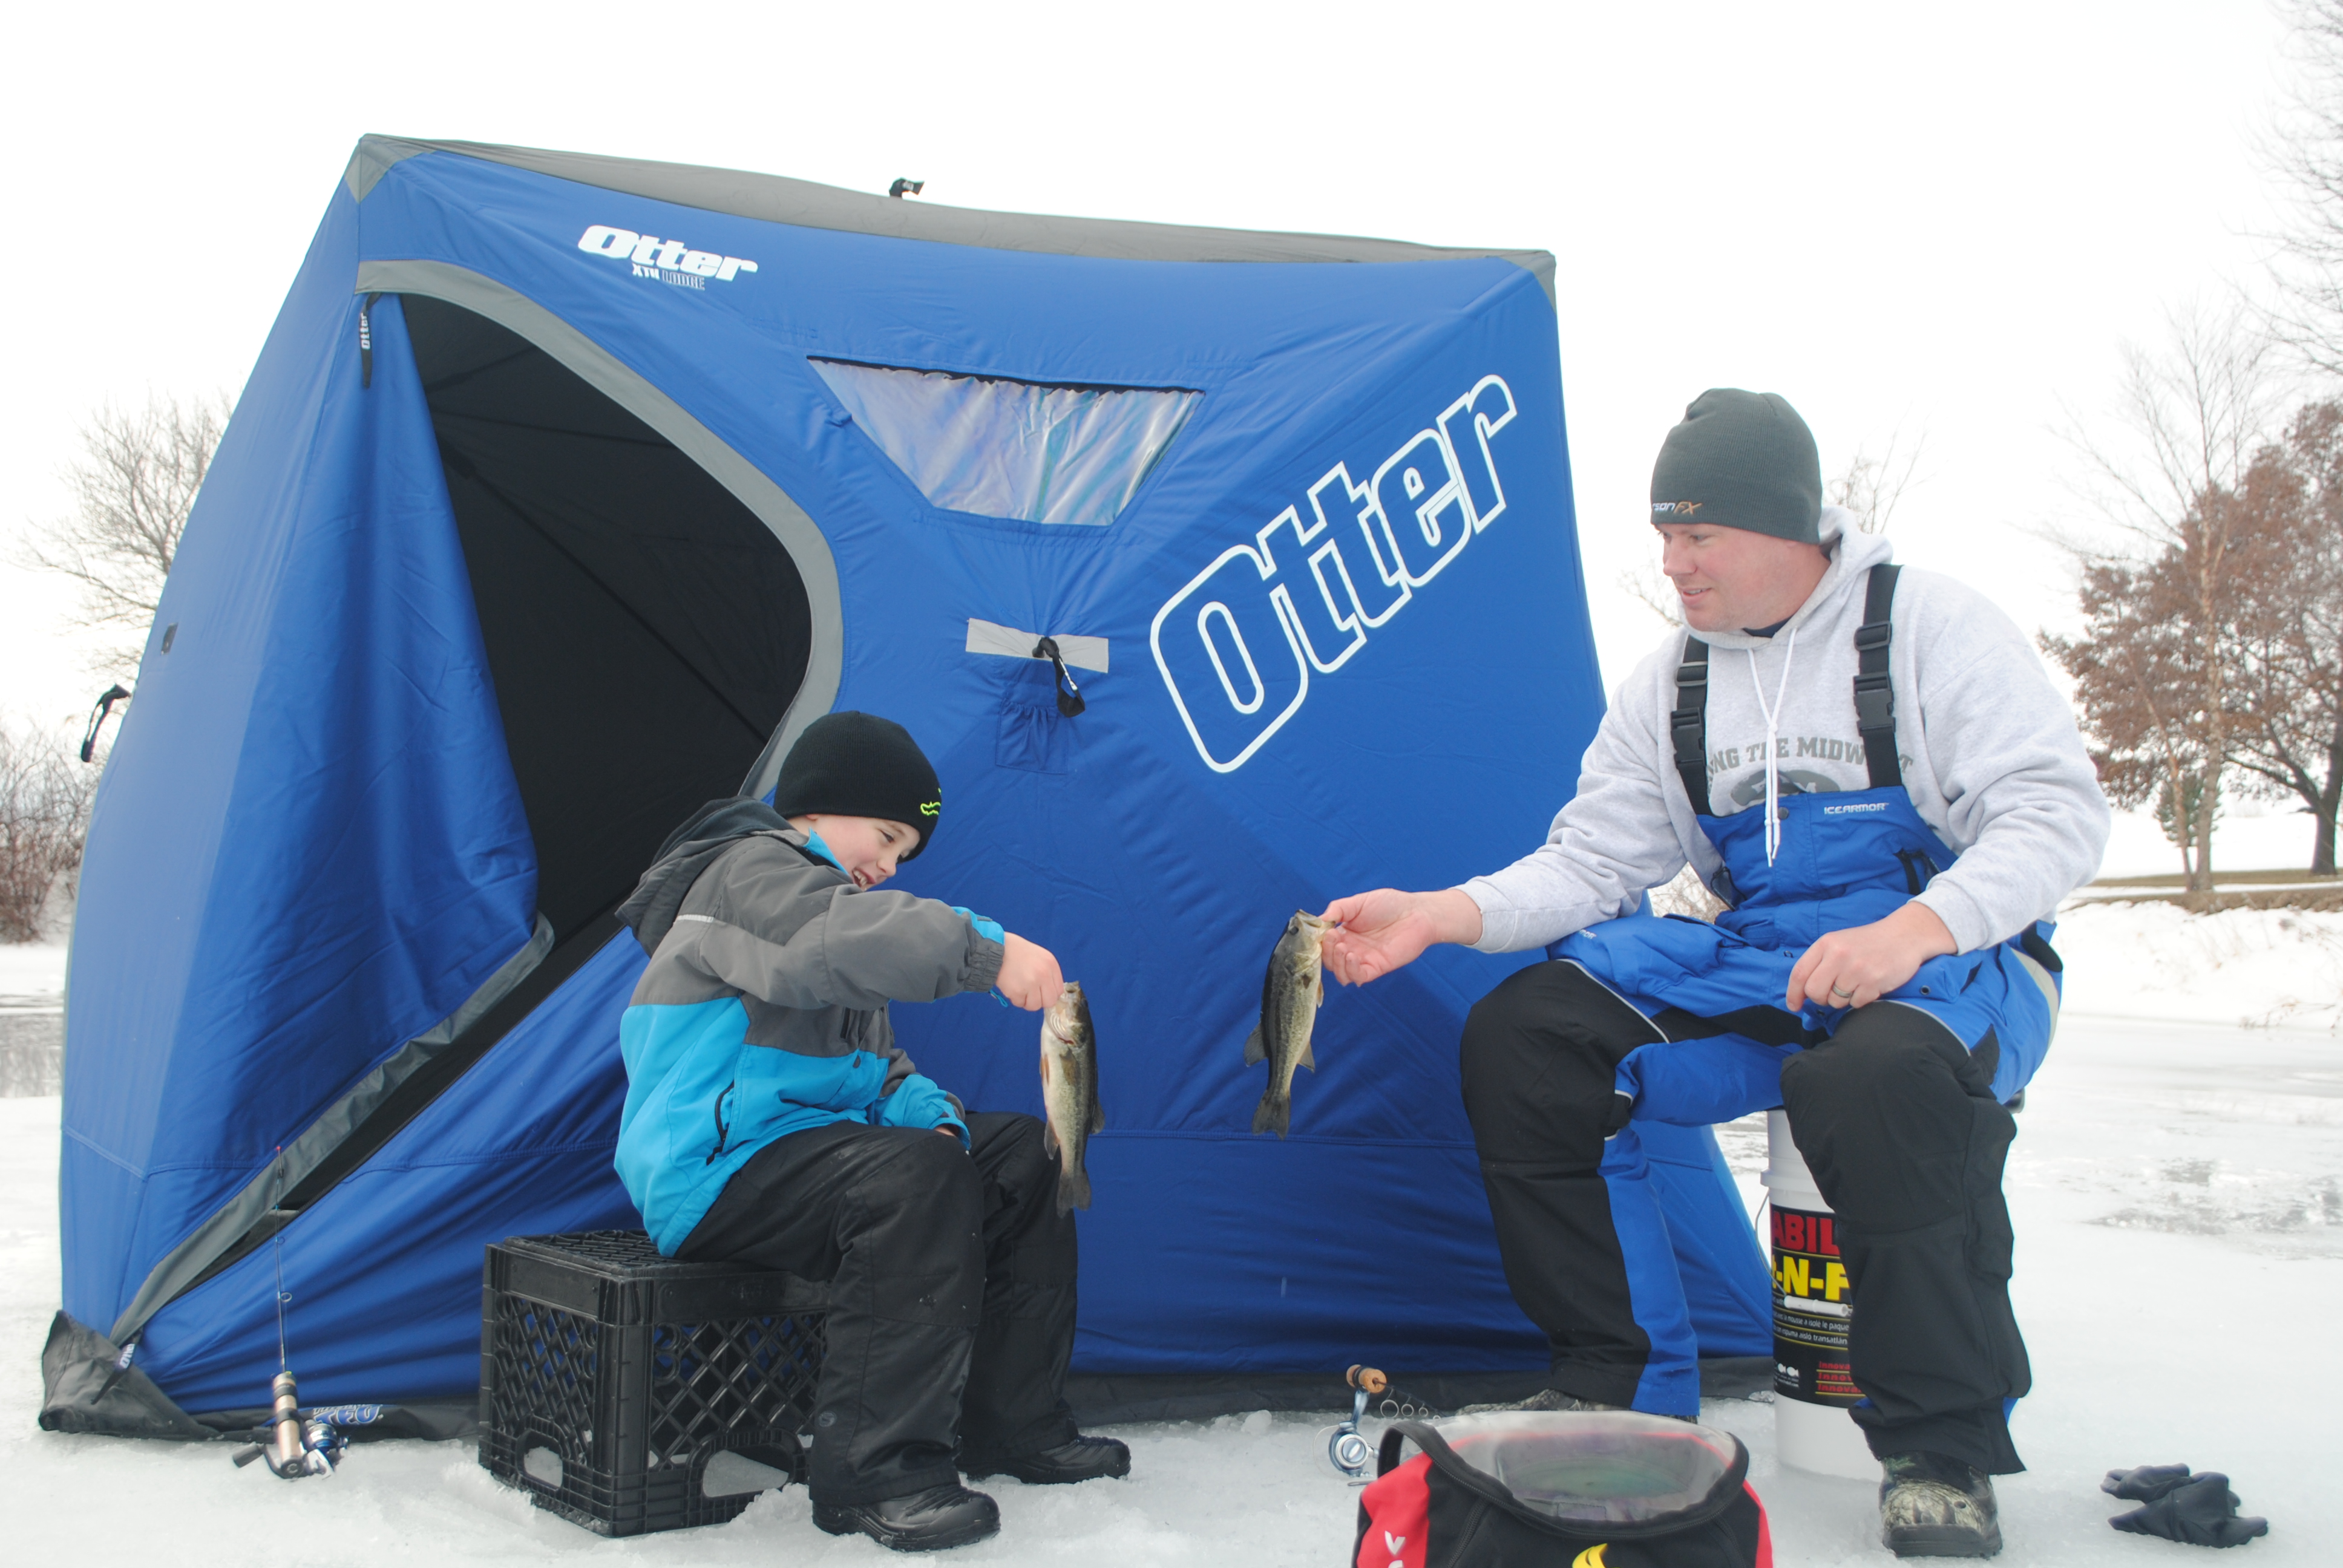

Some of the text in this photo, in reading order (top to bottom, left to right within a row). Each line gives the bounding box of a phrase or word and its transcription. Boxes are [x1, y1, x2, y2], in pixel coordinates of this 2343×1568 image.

[578, 224, 758, 282] Otter
[662, 270, 705, 290] LODGE
[360, 313, 370, 350] Otter
[1150, 374, 1517, 773] Otter
[1797, 736, 1913, 773] MIDWT
